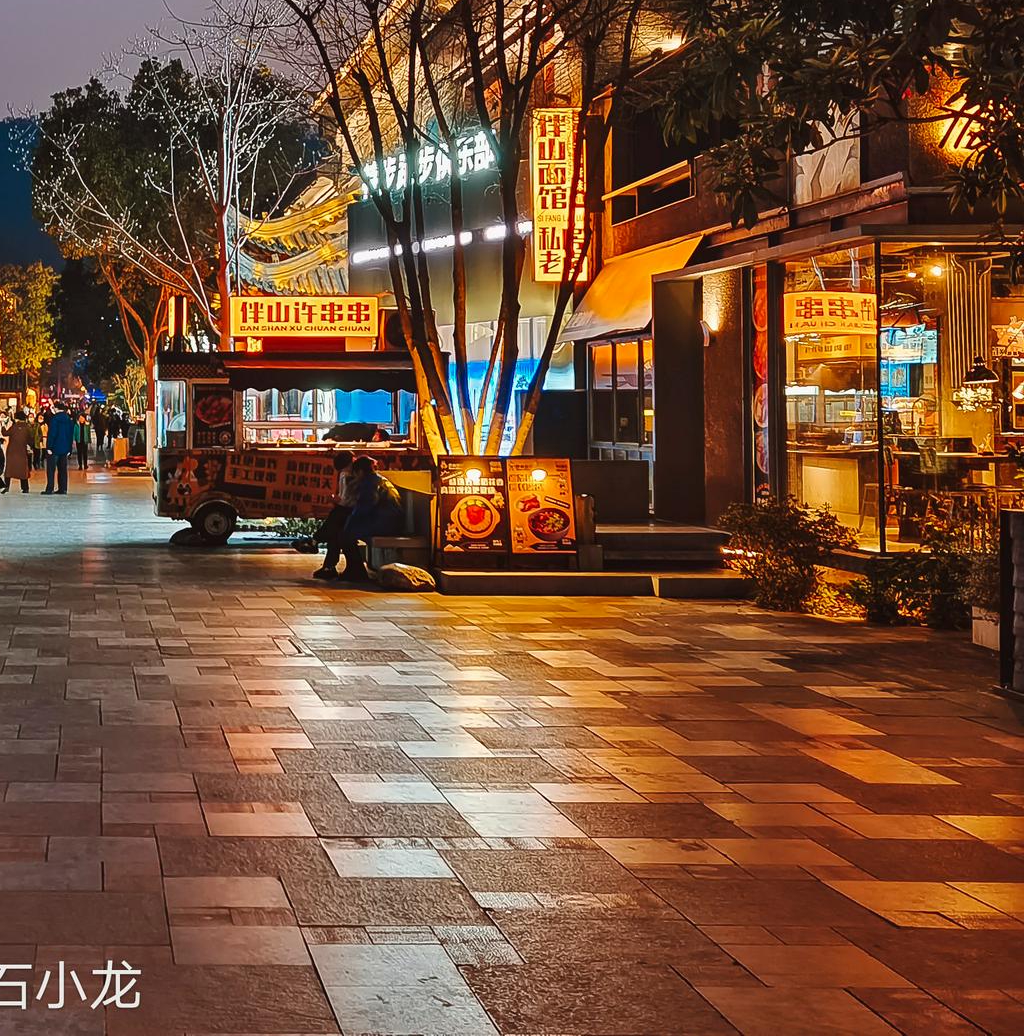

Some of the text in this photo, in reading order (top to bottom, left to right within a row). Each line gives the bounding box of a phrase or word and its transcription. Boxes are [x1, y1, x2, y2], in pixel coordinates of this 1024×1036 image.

[538, 114, 567, 210] 伴山面馆
[240, 301, 370, 324] 伴山许串串
